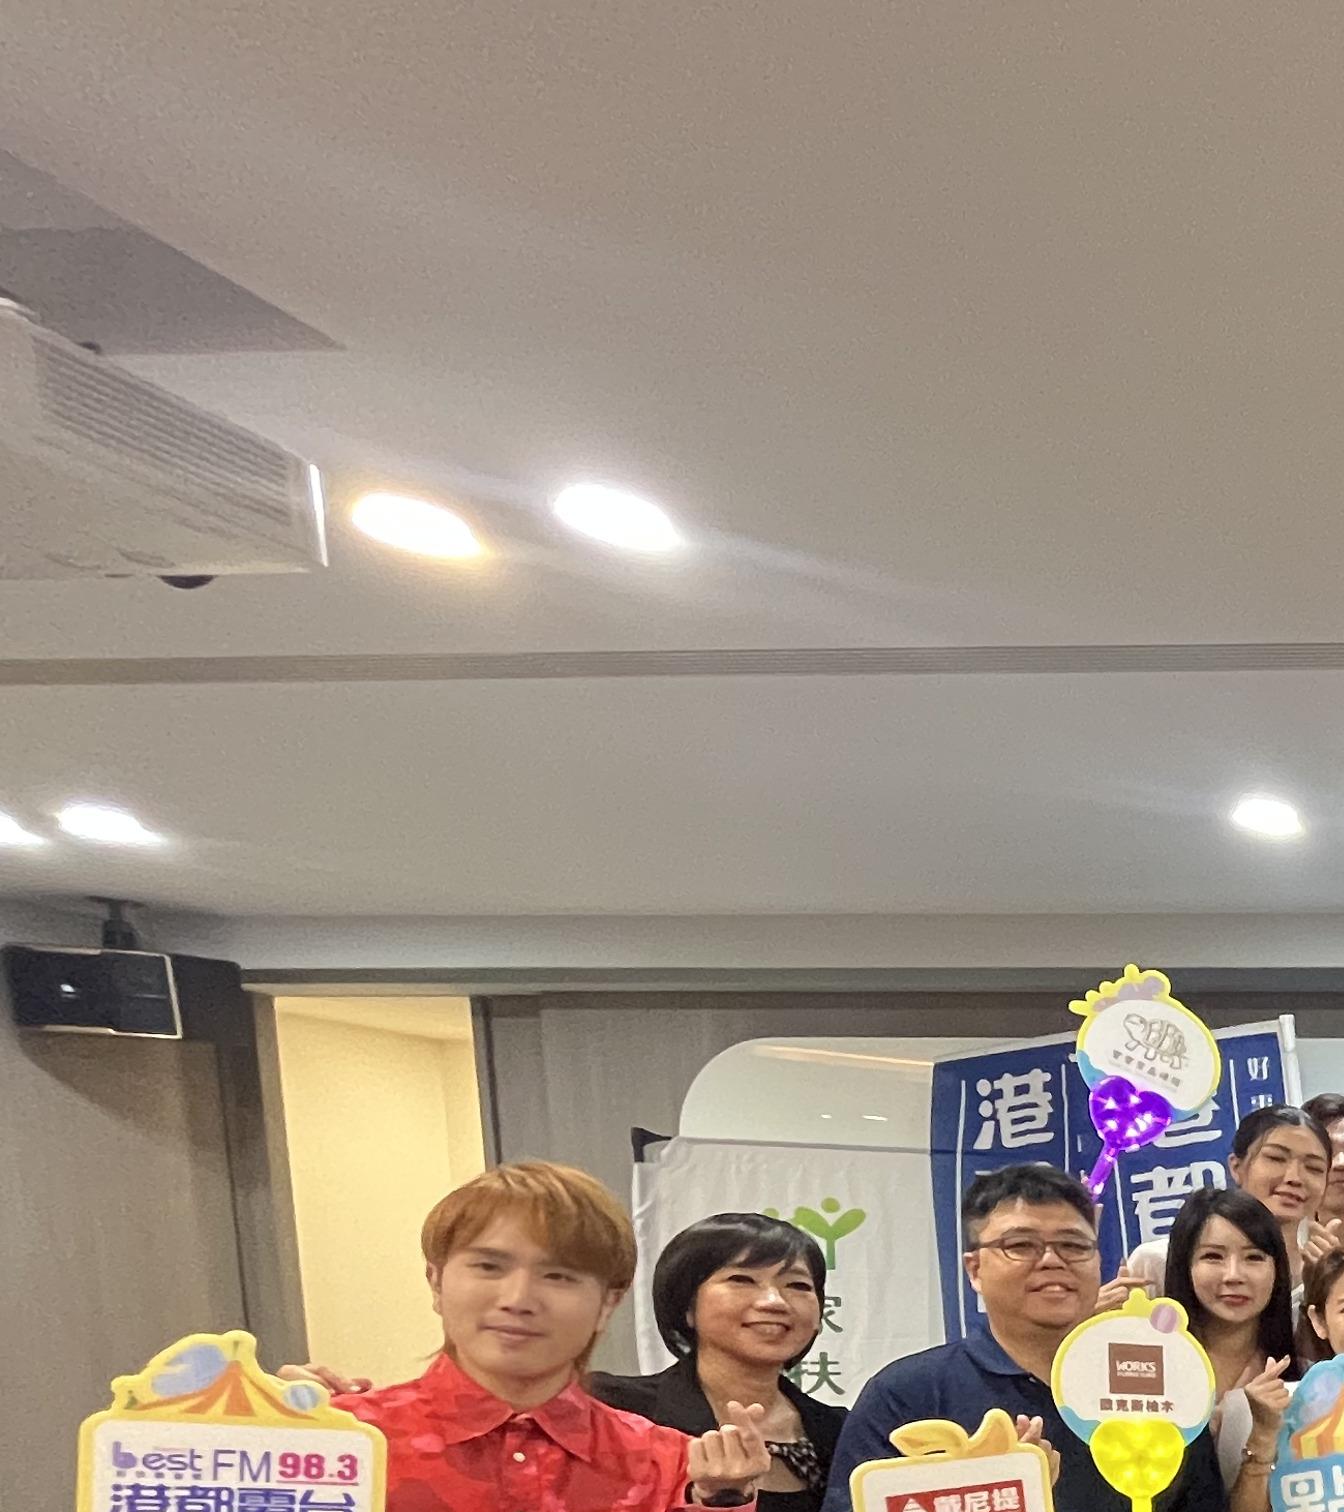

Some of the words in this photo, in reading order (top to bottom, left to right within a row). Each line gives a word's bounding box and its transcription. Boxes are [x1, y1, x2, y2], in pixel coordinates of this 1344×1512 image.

[1115, 1360, 1157, 1373] WORKS
[212, 1449, 272, 1482] FM
[278, 1452, 359, 1481] 98.3
